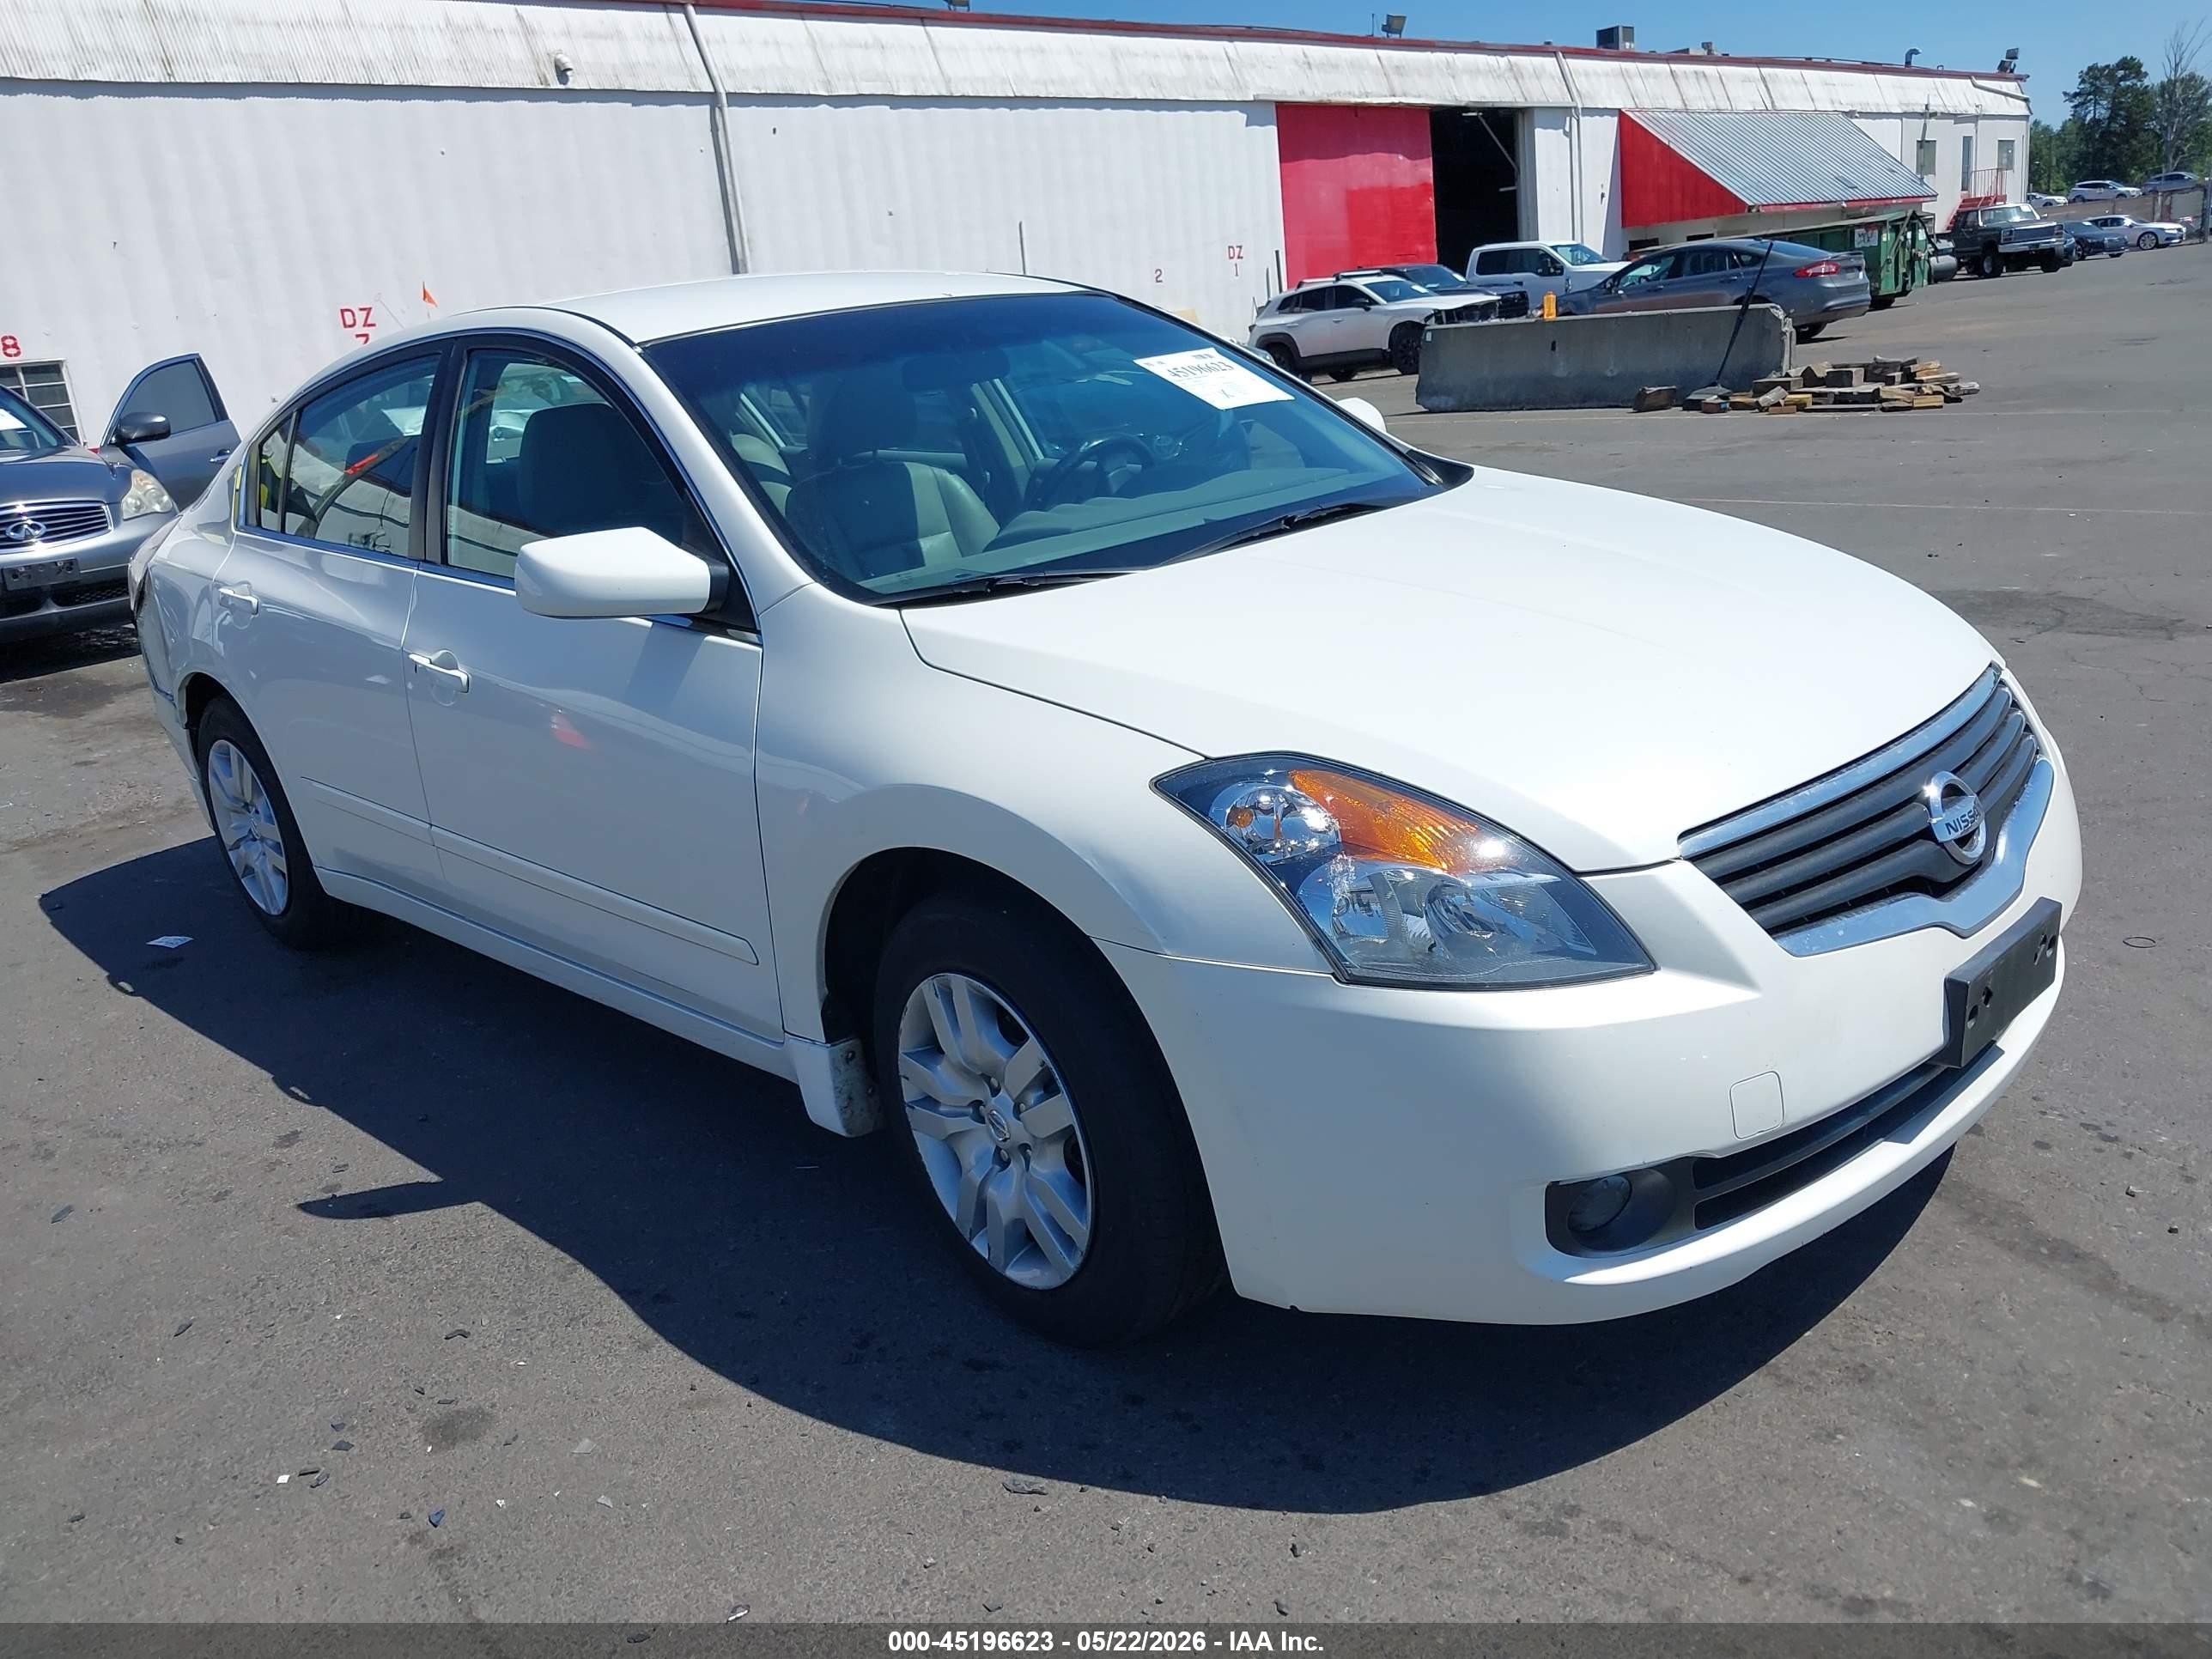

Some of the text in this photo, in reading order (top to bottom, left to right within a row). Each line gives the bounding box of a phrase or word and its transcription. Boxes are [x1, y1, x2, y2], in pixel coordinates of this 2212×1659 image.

[1227, 245, 1244, 260] DZ
[1154, 268, 1164, 283] 2
[339, 307, 377, 329] DZ
[0, 335, 21, 358] 8
[1167, 361, 1235, 379] 45196623
[1944, 808, 1980, 836] NISS
